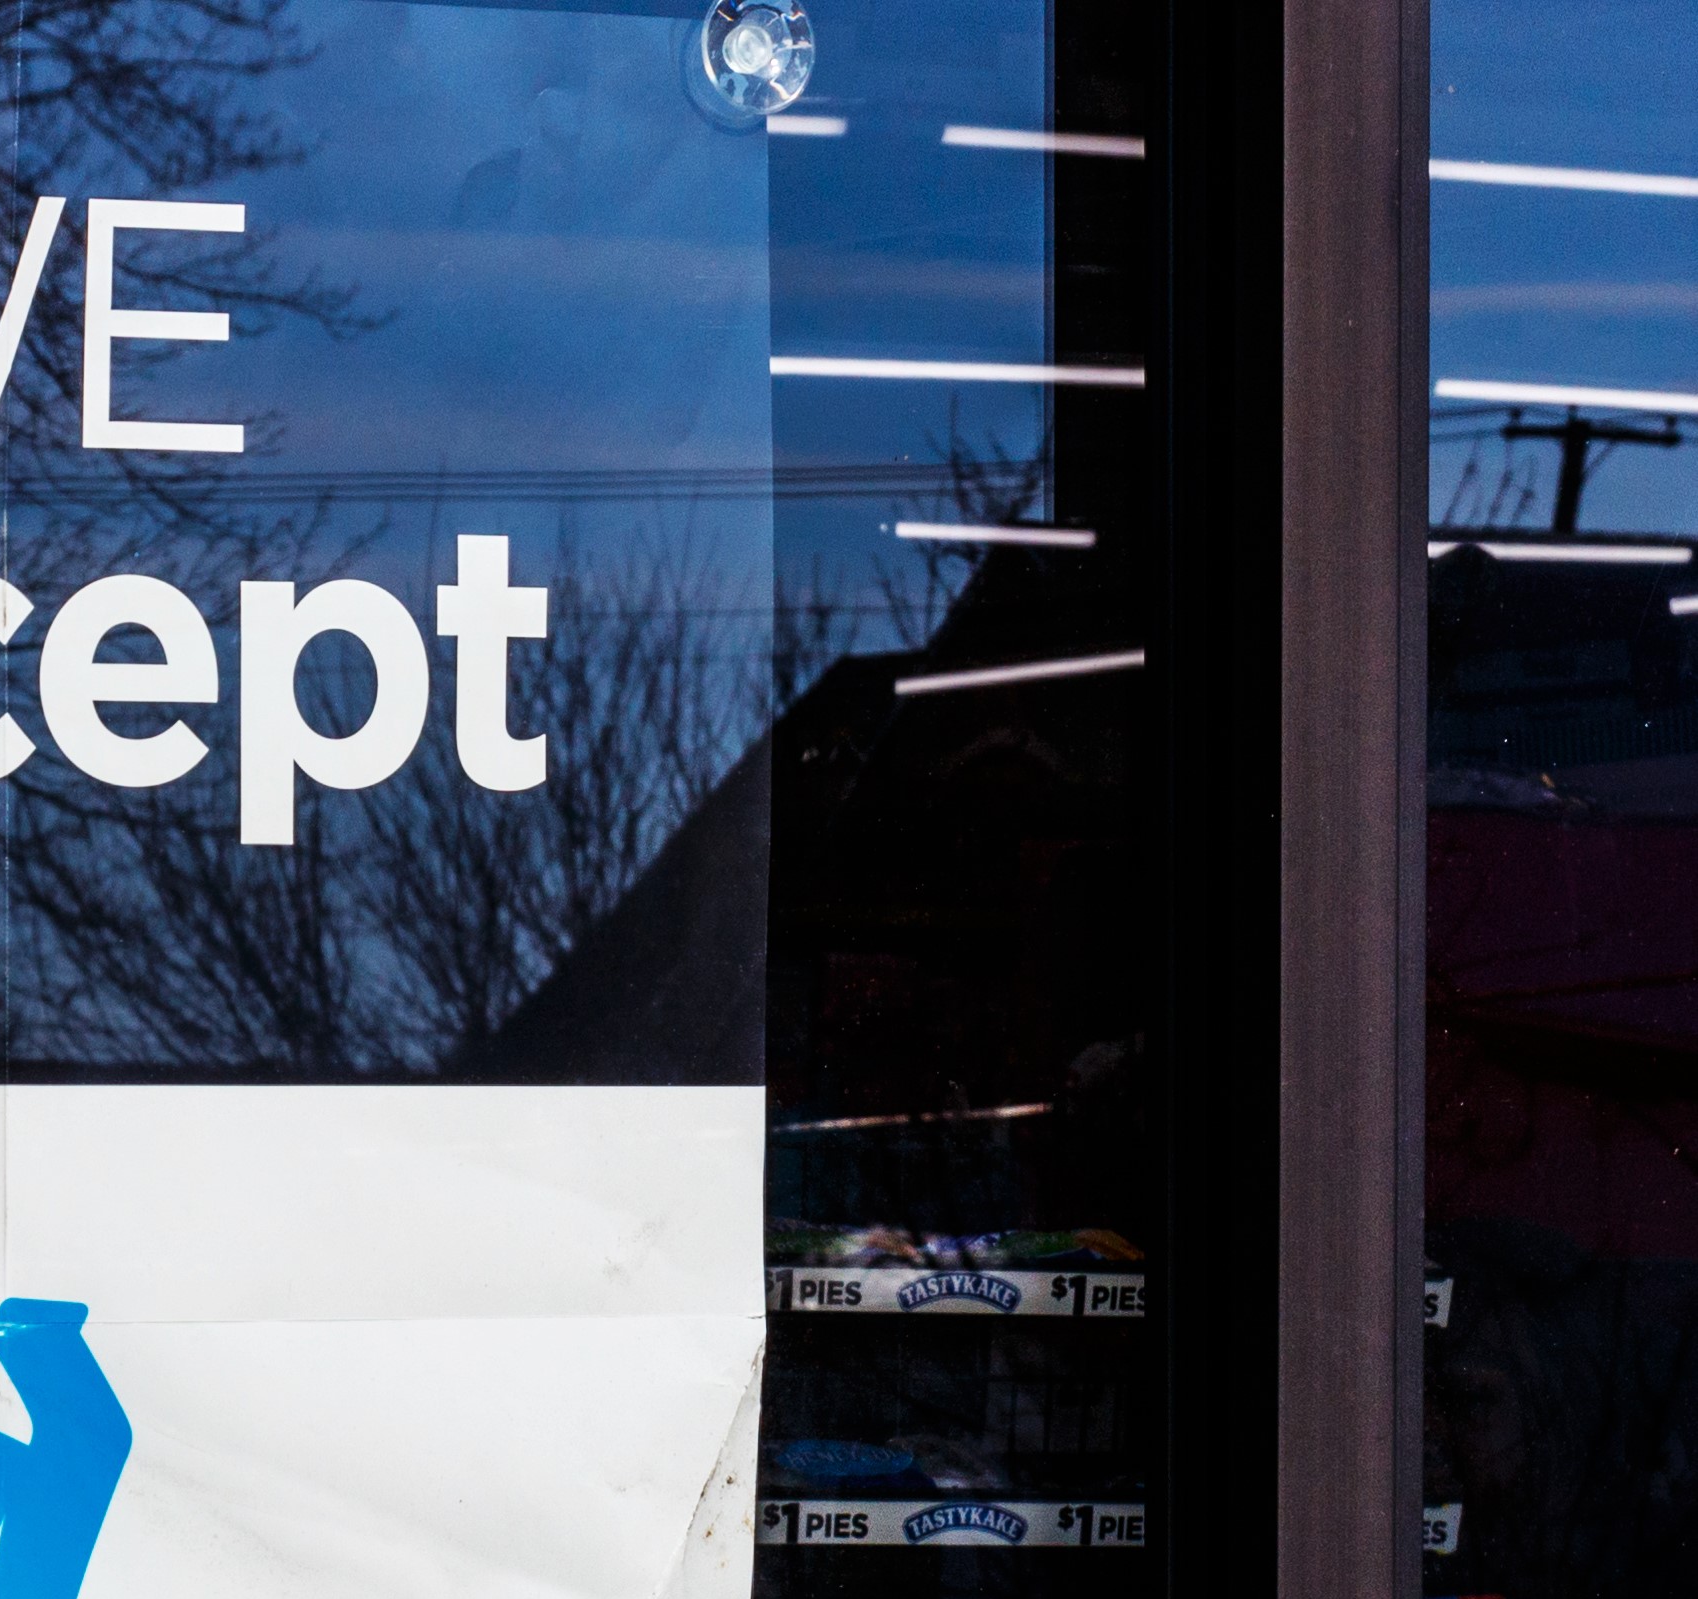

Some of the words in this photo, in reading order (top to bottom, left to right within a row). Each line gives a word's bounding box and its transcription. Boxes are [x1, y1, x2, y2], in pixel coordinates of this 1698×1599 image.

[800, 1280, 862, 1306] PIES
[903, 1272, 1017, 1311] TASTYKAKE
[762, 1503, 799, 1544] $1
[805, 1512, 869, 1539] PIES
[907, 1505, 1022, 1542] TASTYKAKE
[1057, 1504, 1094, 1546] $1
